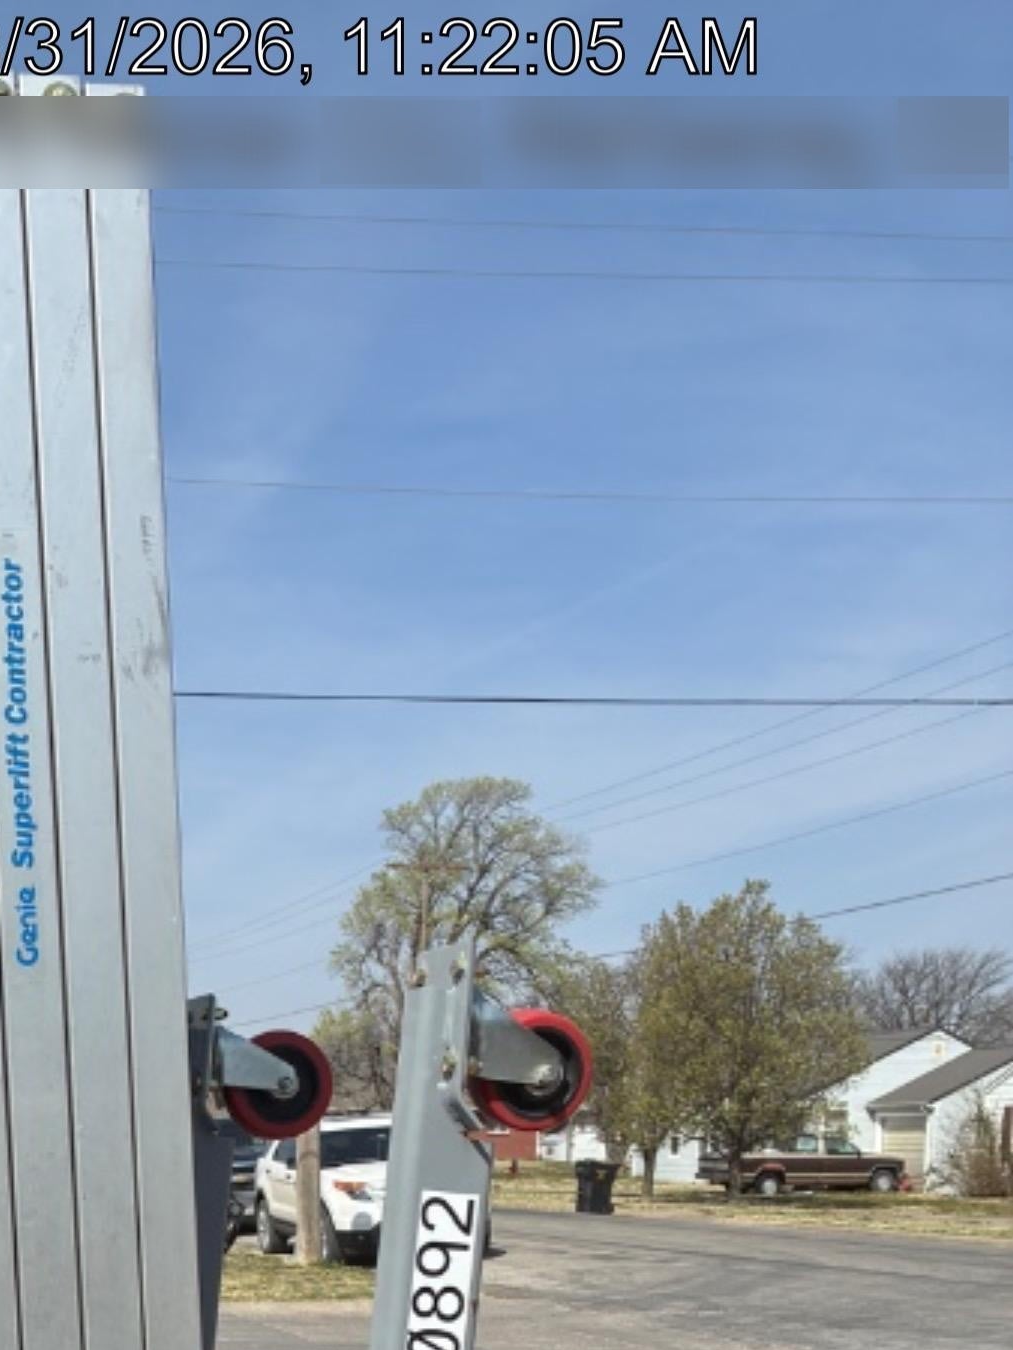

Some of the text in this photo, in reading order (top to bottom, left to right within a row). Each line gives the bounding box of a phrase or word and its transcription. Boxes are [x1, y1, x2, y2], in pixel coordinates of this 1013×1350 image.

[2, 557, 40, 967] Genie Superlift Contractor
